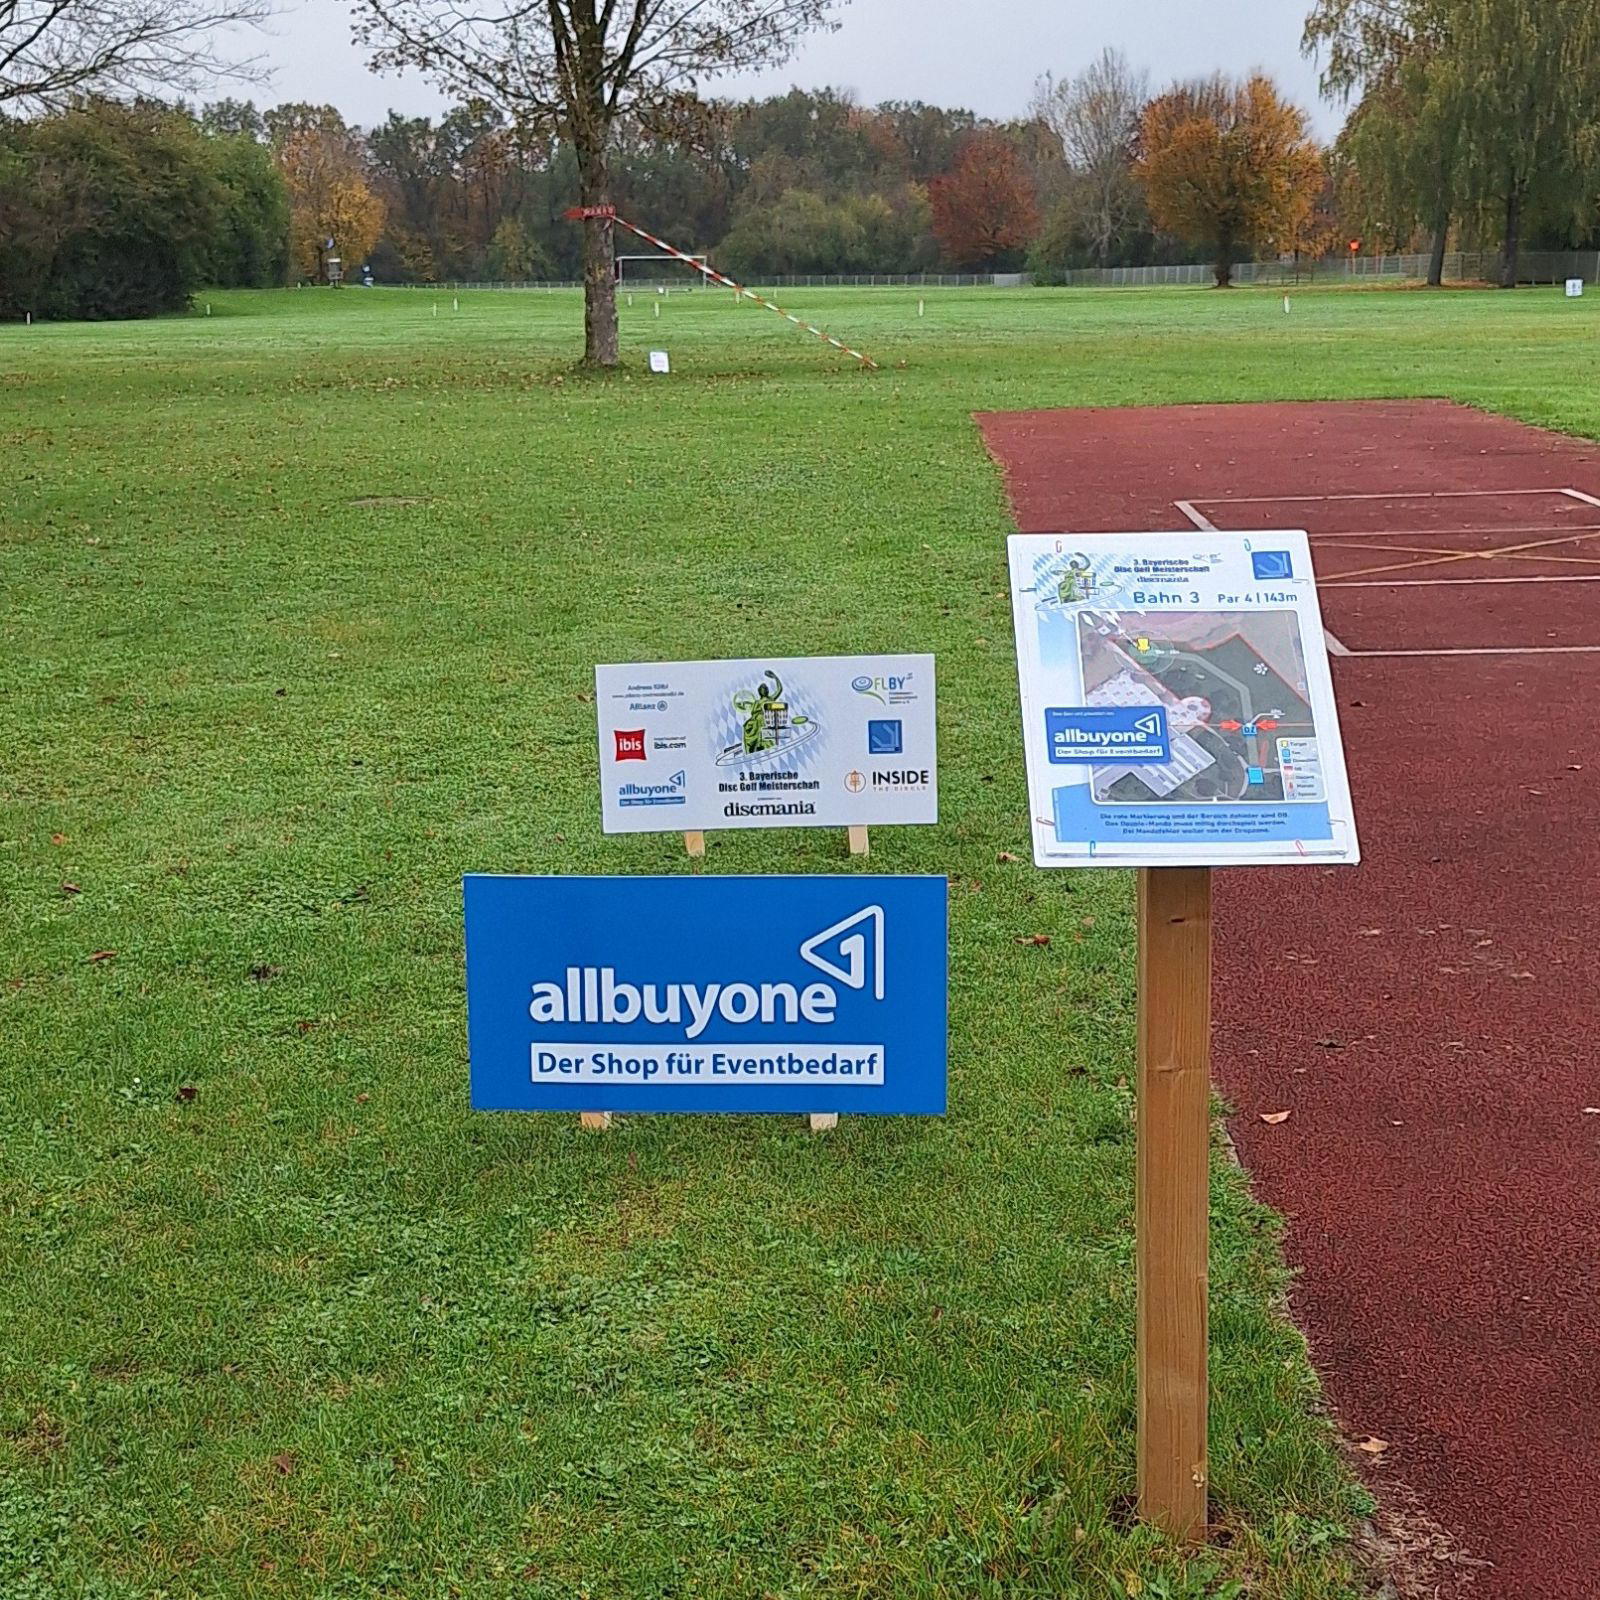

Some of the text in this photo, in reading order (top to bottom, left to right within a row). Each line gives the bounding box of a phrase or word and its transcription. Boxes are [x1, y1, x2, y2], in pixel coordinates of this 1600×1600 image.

[1142, 558, 1189, 567] Bayerische
[1152, 565, 1210, 573] Meisterschaft
[1133, 591, 1200, 604] Bahn 3
[1217, 593, 1240, 604] Par
[1245, 593, 1253, 603] 4
[1264, 592, 1298, 603] 143m
[1054, 728, 1147, 745] allbuyone
[619, 738, 642, 752] ibis
[654, 741, 687, 749] ibis.com
[740, 771, 799, 781] 3. Bayerische
[872, 770, 929, 785] INSIDE
[619, 784, 677, 796] allbuyone
[719, 780, 820, 792] Disc Golf Meisterschaft
[724, 801, 816, 817] discmania
[529, 967, 837, 1039] allbuyone
[538, 1052, 879, 1080] Der Shop für Eventbedarf
